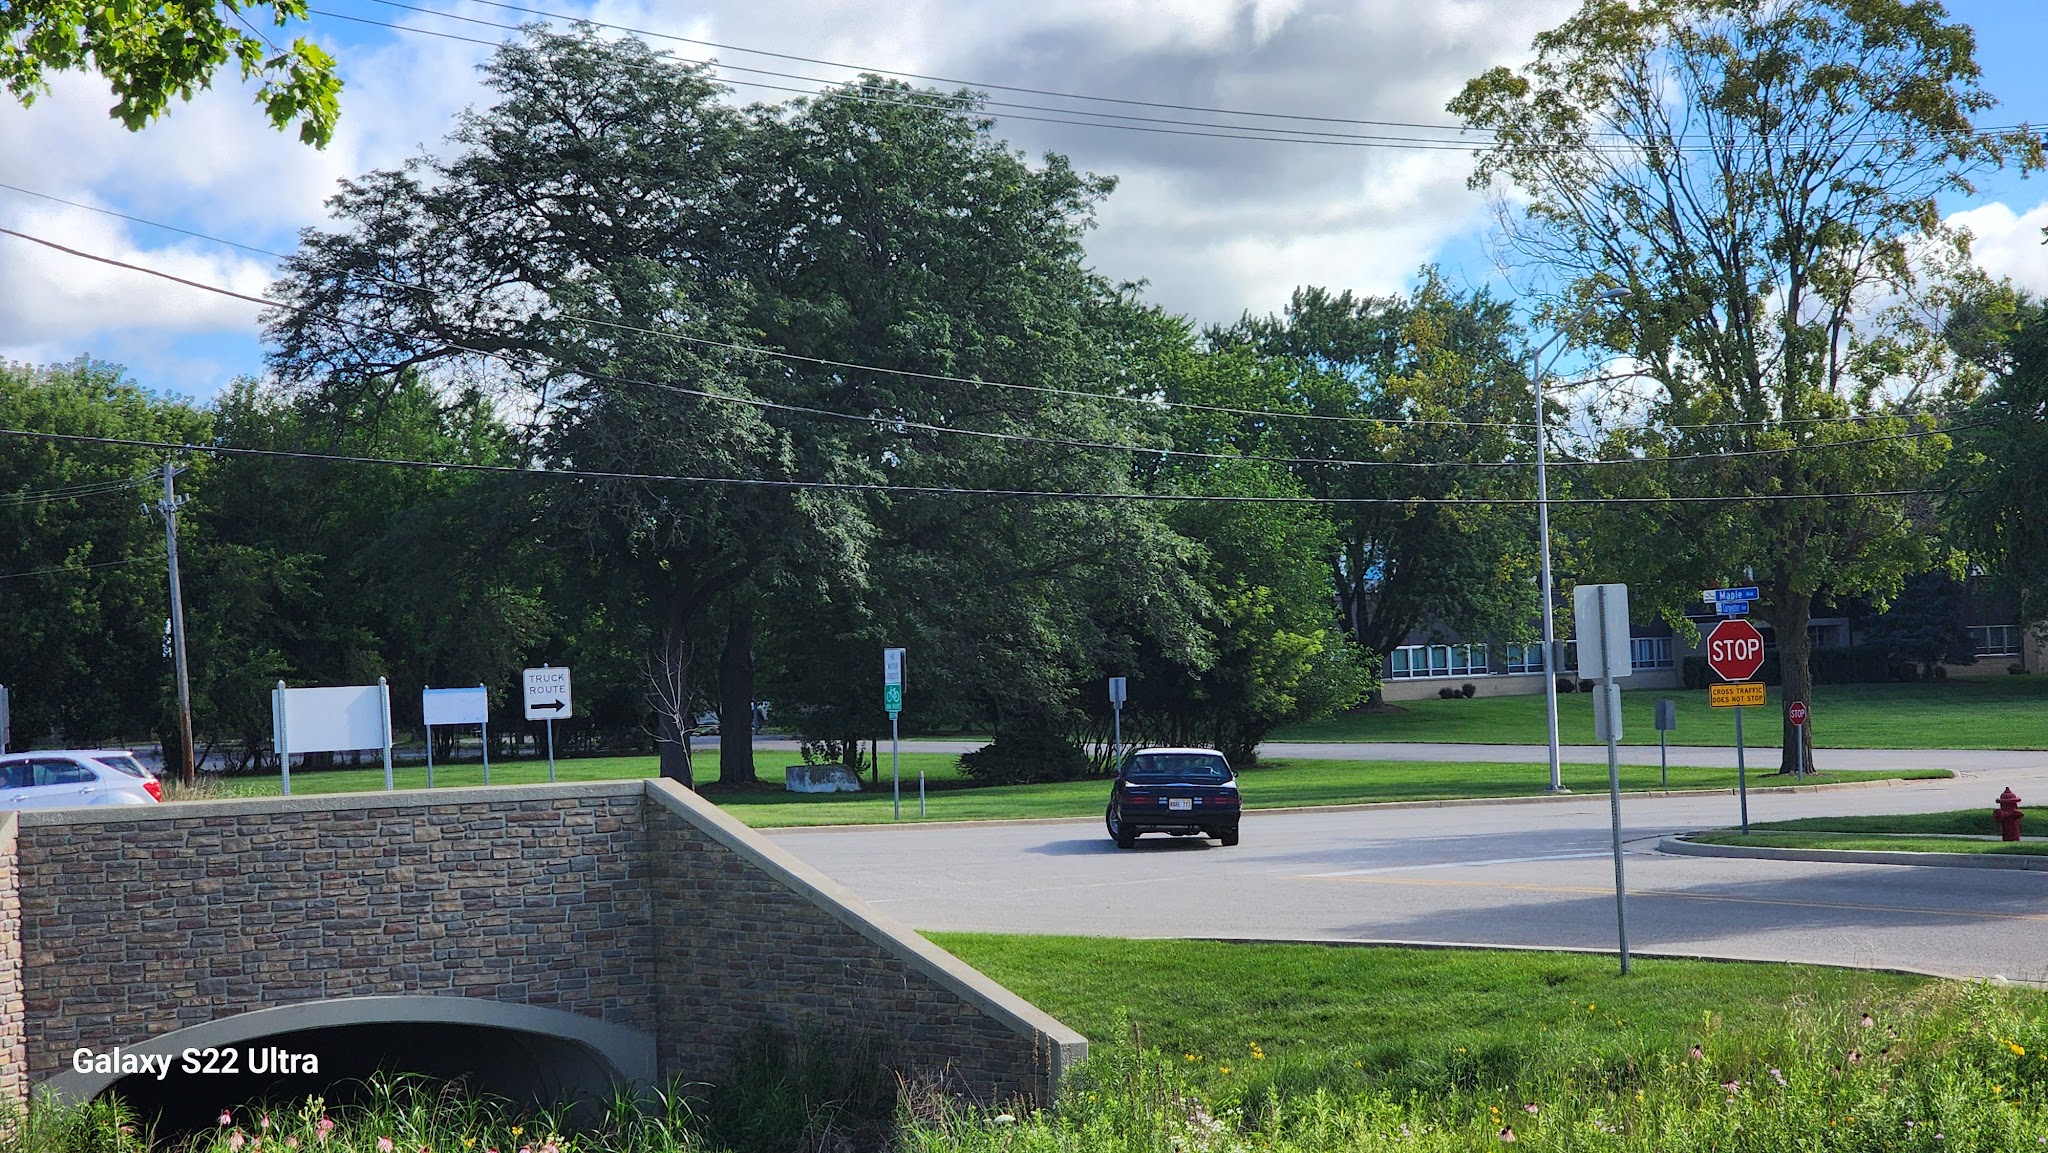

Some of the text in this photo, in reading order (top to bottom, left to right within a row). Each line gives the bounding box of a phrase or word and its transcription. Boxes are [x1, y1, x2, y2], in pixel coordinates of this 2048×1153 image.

[1720, 590, 1743, 600] Maple
[1712, 639, 1760, 661] STOP
[529, 674, 565, 683] TRUCK
[529, 685, 566, 694] ROUTE
[1712, 687, 1763, 696] CROSS TRAFFIC
[1790, 709, 1805, 719] STOP
